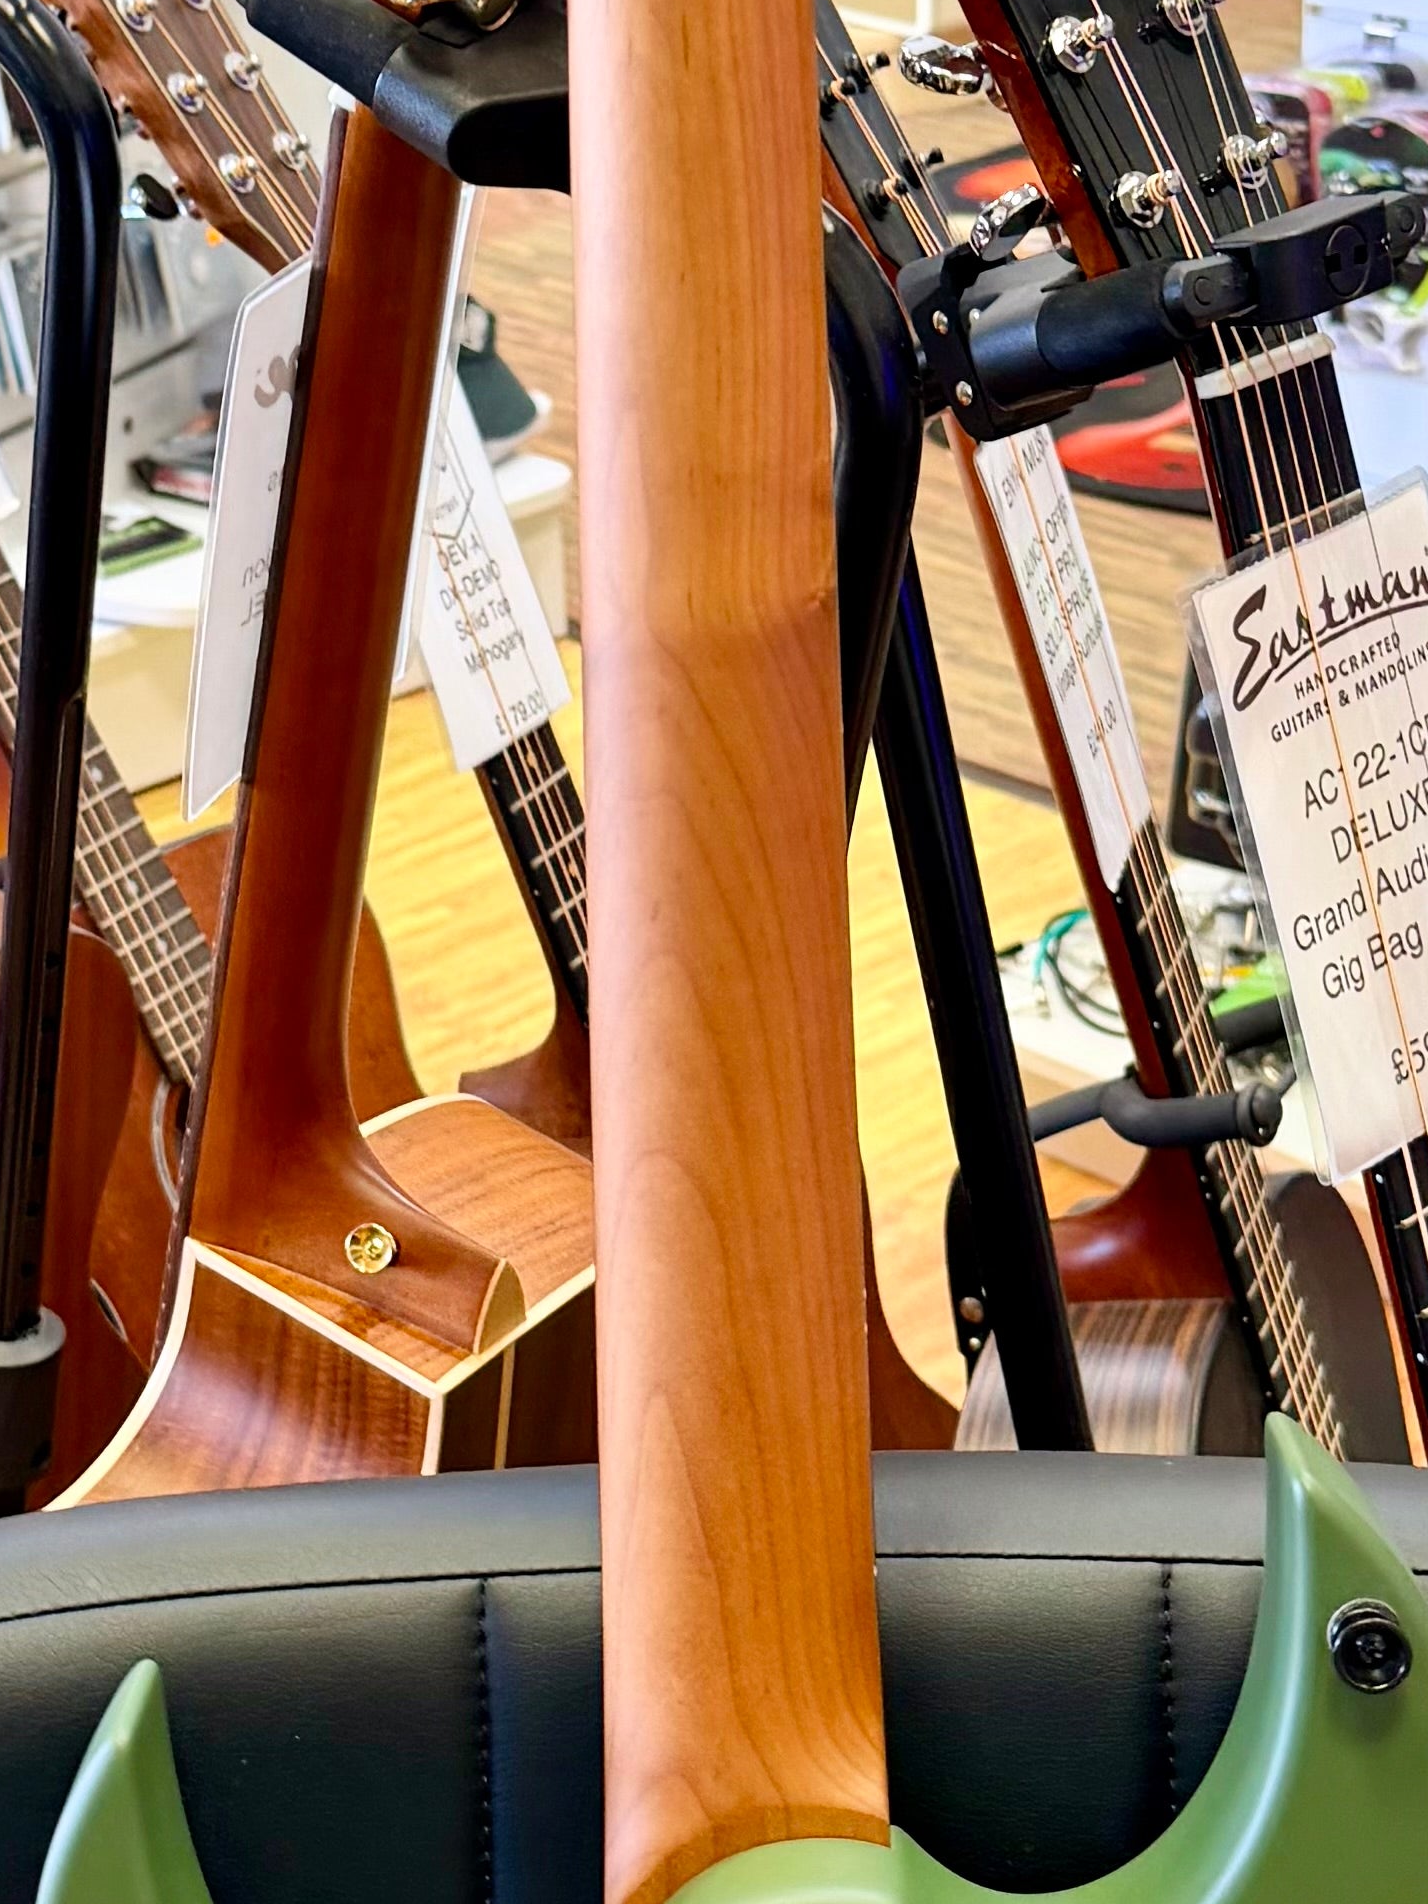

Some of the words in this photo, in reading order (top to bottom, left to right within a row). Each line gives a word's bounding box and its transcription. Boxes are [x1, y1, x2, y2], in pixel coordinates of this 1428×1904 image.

[1293, 630, 1401, 700] HANDCRAFTED
[1270, 697, 1332, 743] GUITARS
[1338, 688, 1351, 708] &
[1292, 878, 1368, 953] Grand
[1322, 952, 1366, 1000] Gig
[1367, 919, 1425, 974] Bag
